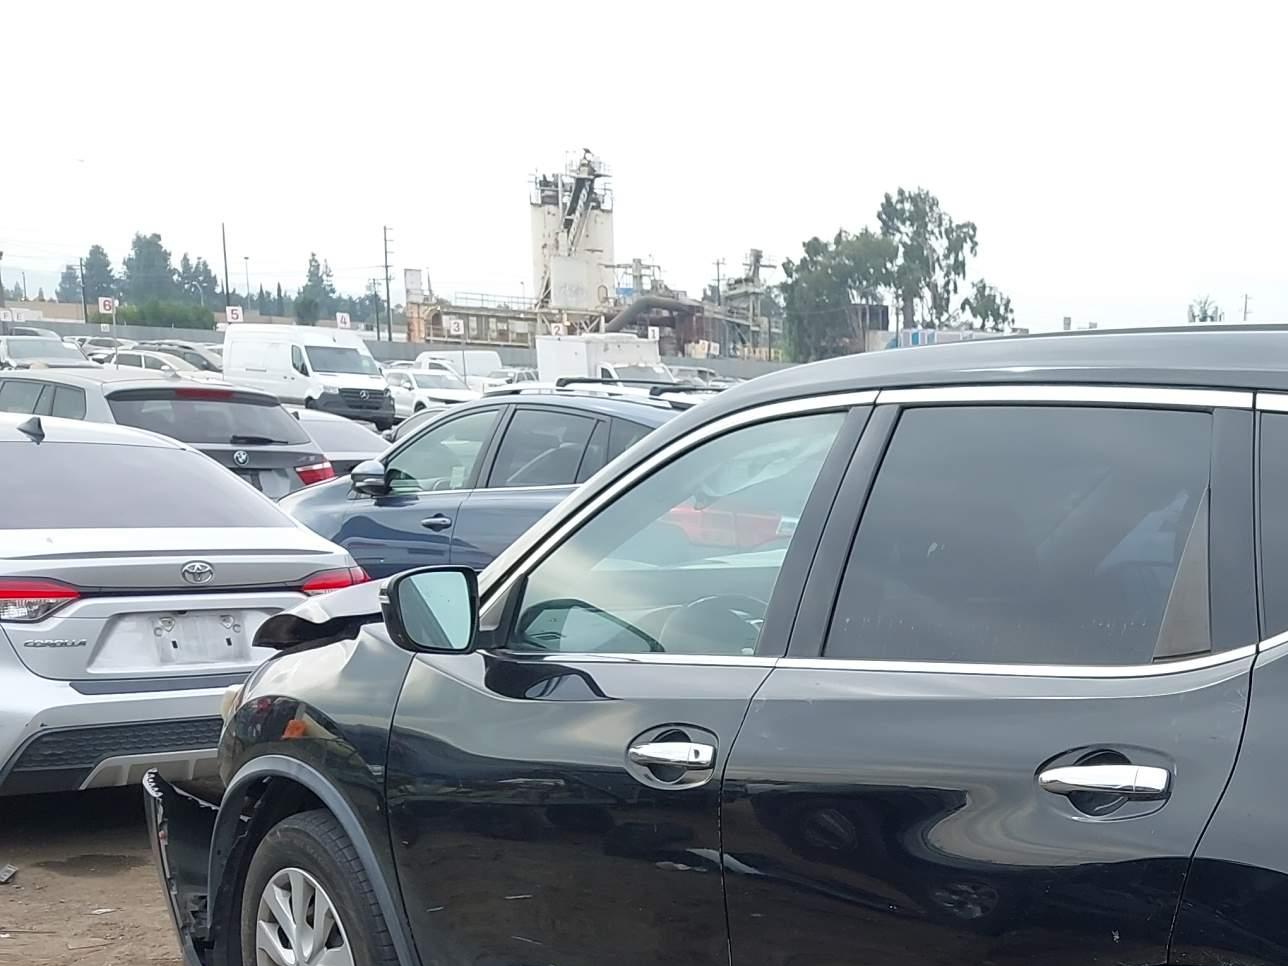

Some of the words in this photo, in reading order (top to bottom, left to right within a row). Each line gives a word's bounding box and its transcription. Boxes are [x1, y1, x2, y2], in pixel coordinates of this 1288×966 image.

[103, 299, 112, 311] 6
[231, 308, 240, 320] 5
[453, 321, 460, 332] 3
[553, 325, 561, 336] 2
[24, 639, 87, 648] COROLLA
